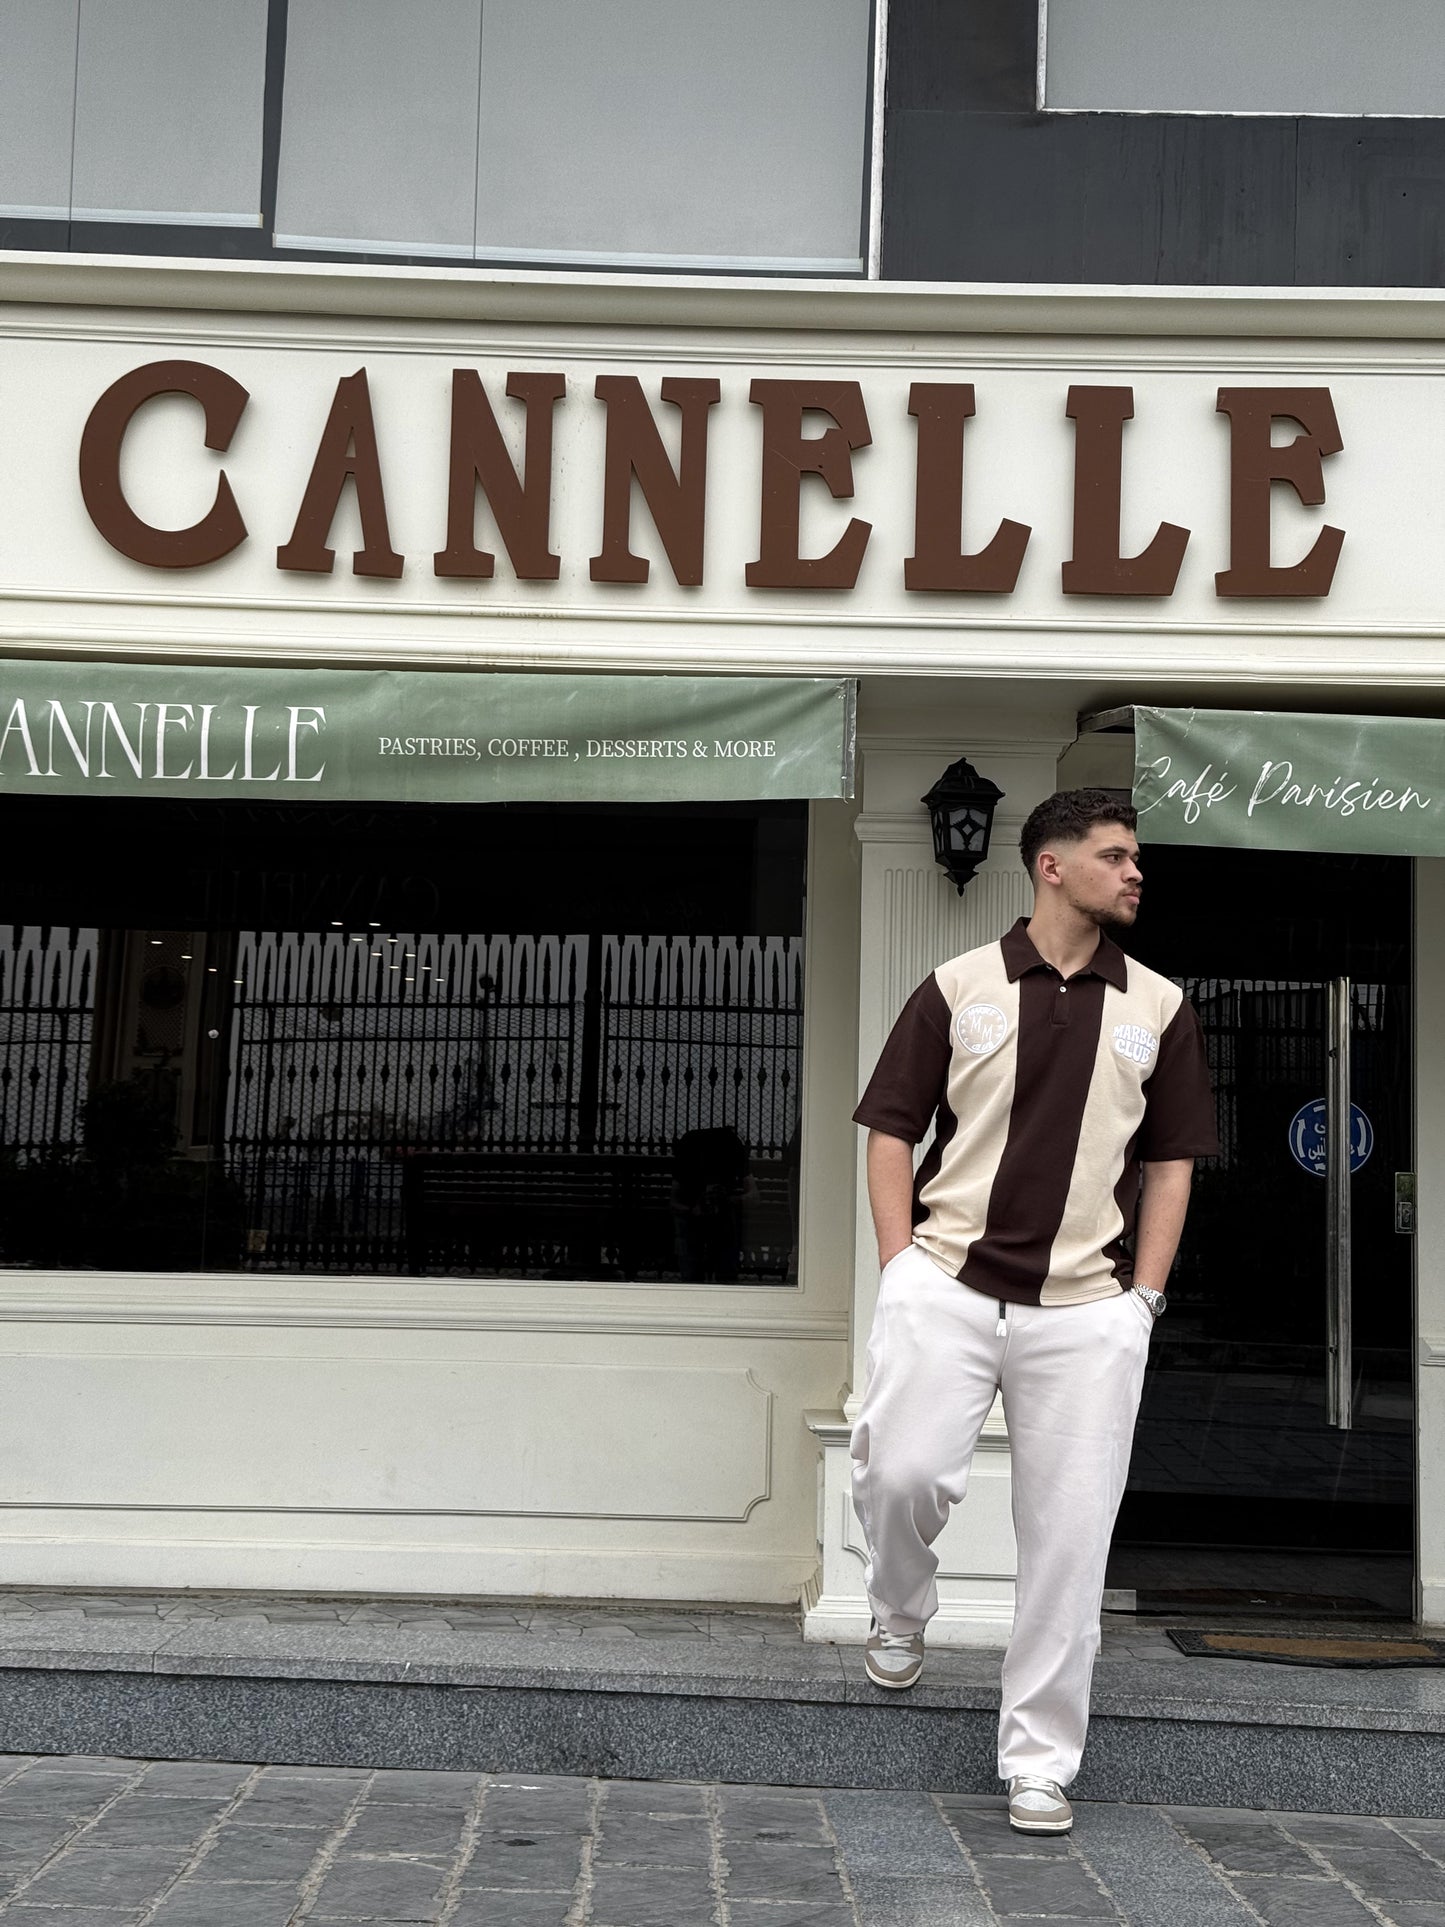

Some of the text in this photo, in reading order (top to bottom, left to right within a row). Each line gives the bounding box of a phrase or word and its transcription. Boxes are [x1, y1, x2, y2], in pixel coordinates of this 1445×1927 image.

[80, 360, 1346, 597] CANNELLE
[0, 697, 326, 782] ANNELLE
[378, 737, 482, 761] PASTRIES,
[585, 739, 687, 759] DESSERTS
[692, 740, 708, 758] &
[713, 740, 777, 758] MORE
[1132, 756, 1431, 824] Café Parisien
[1112, 1024, 1157, 1051] MARBLE
[1115, 1038, 1151, 1064] CLUB
